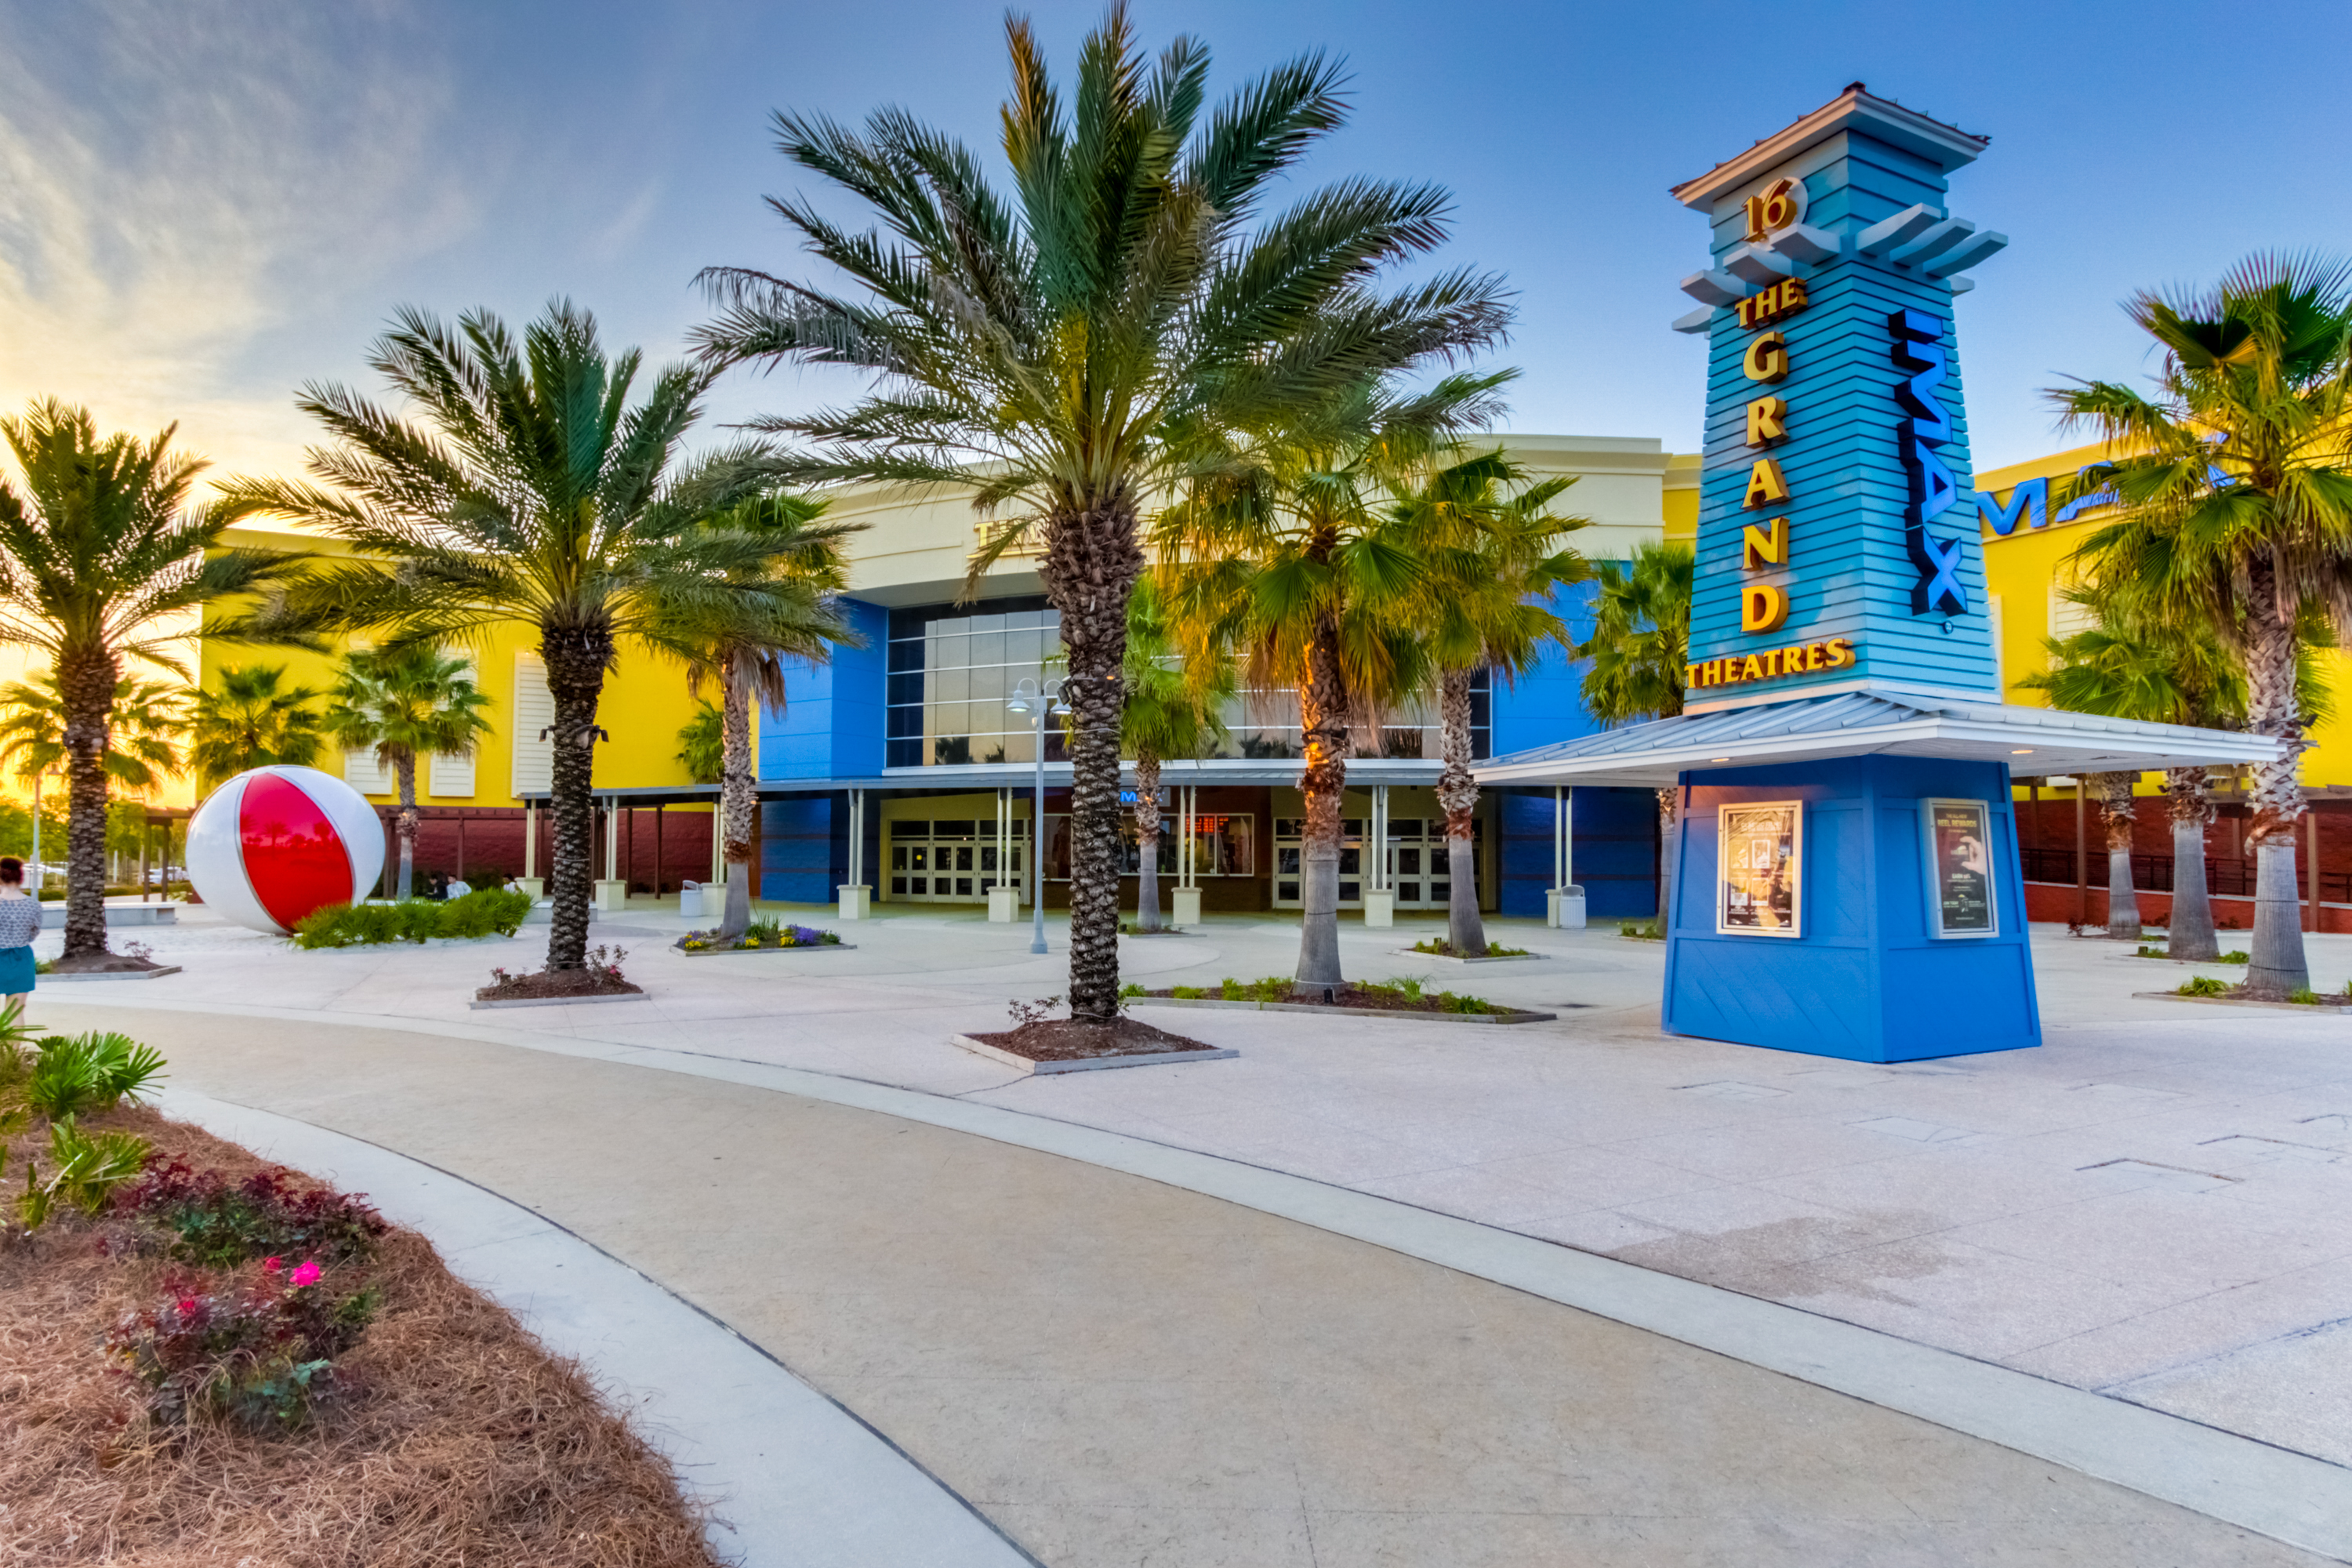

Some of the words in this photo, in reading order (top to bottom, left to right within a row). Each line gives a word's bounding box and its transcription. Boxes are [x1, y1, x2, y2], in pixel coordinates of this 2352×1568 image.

[1741, 177, 1798, 242] 16
[1735, 277, 1808, 330] THE
[1740, 331, 1791, 636] GRAND
[1888, 308, 1969, 617] IMAX
[1684, 637, 1857, 689] THEATRES
